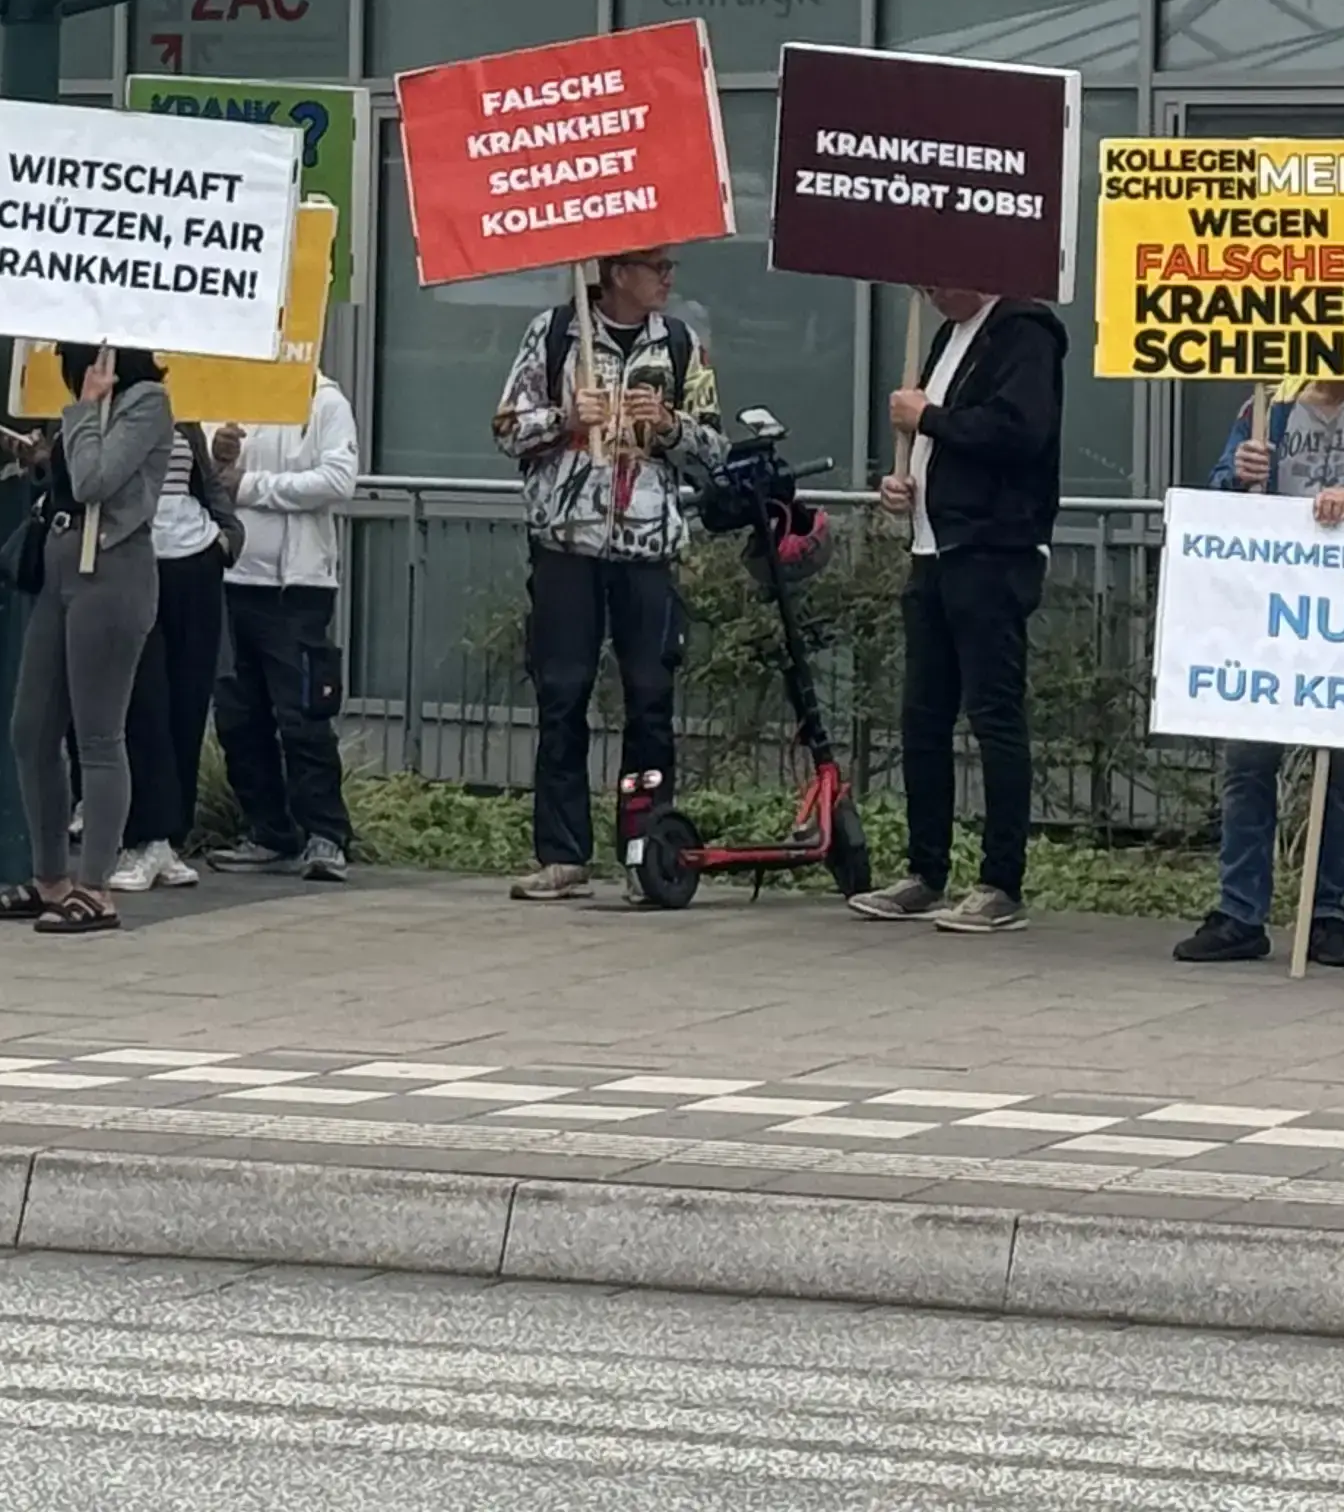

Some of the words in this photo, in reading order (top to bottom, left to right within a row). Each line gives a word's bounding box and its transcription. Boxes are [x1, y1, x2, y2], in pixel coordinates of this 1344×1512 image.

[481, 69, 625, 117] FALSCHE
[467, 104, 650, 159] KRANKHEIT
[815, 129, 1025, 176] KRANKFEIERN
[8, 152, 244, 203] WIRTSCHAFT
[489, 147, 638, 195] SCHADET
[1105, 148, 1256, 173] KOLLEGEN
[481, 185, 659, 238] KOLLEGEN!
[795, 169, 950, 210] ZERSTÖRT
[955, 187, 1044, 220] JOBS!
[1105, 175, 1257, 201] SCHUFTEN
[183, 217, 265, 254] FAIR
[1188, 207, 1329, 239] WEGEN
[1188, 659, 1280, 705] FÜR
